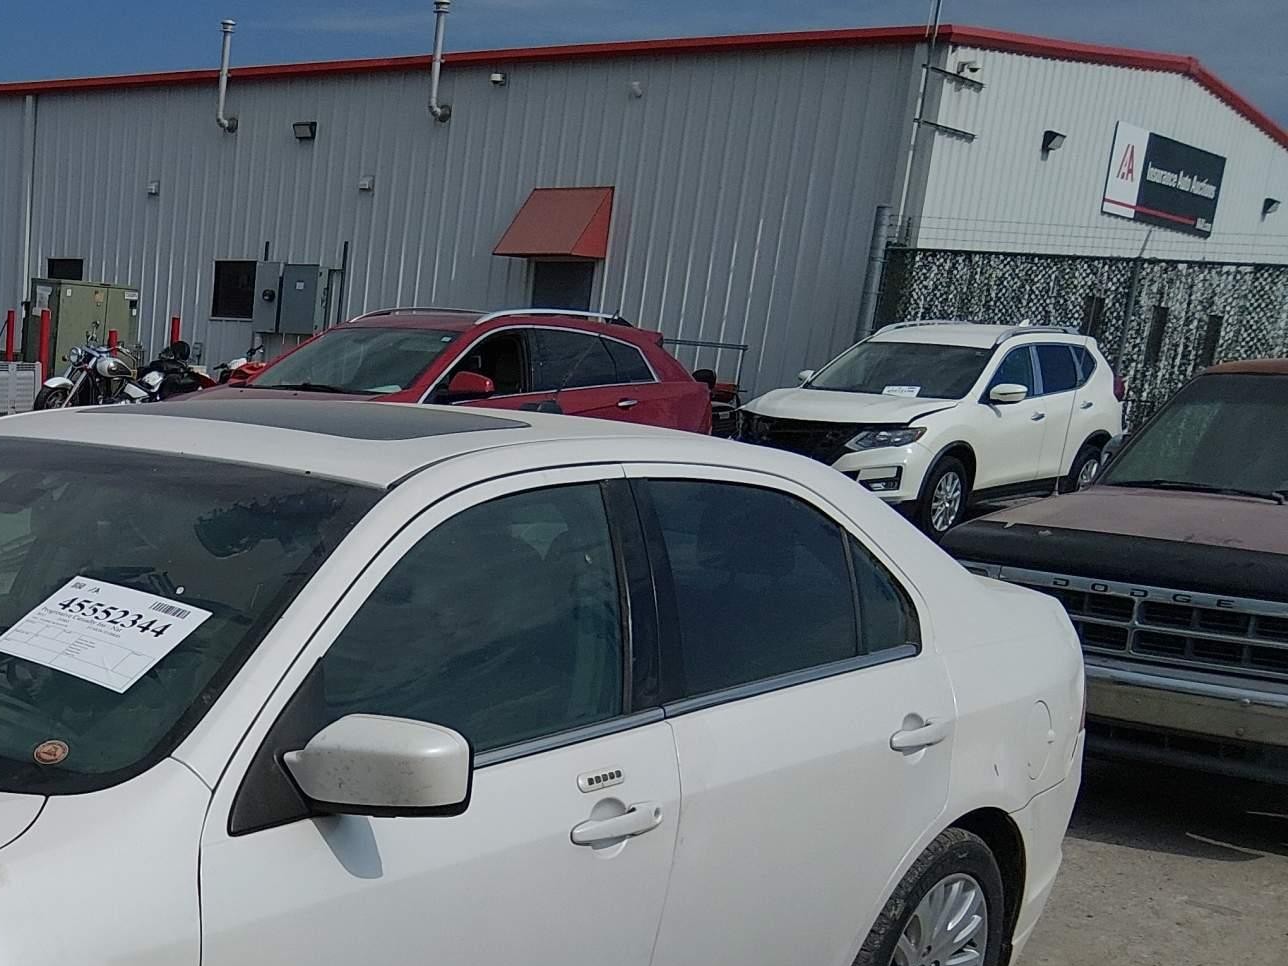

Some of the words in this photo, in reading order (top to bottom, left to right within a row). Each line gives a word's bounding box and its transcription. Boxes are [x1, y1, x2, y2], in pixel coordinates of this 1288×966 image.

[1176, 169, 1192, 193] Auto
[1052, 576, 1235, 609] DODGE
[58, 596, 173, 638] 45552344
